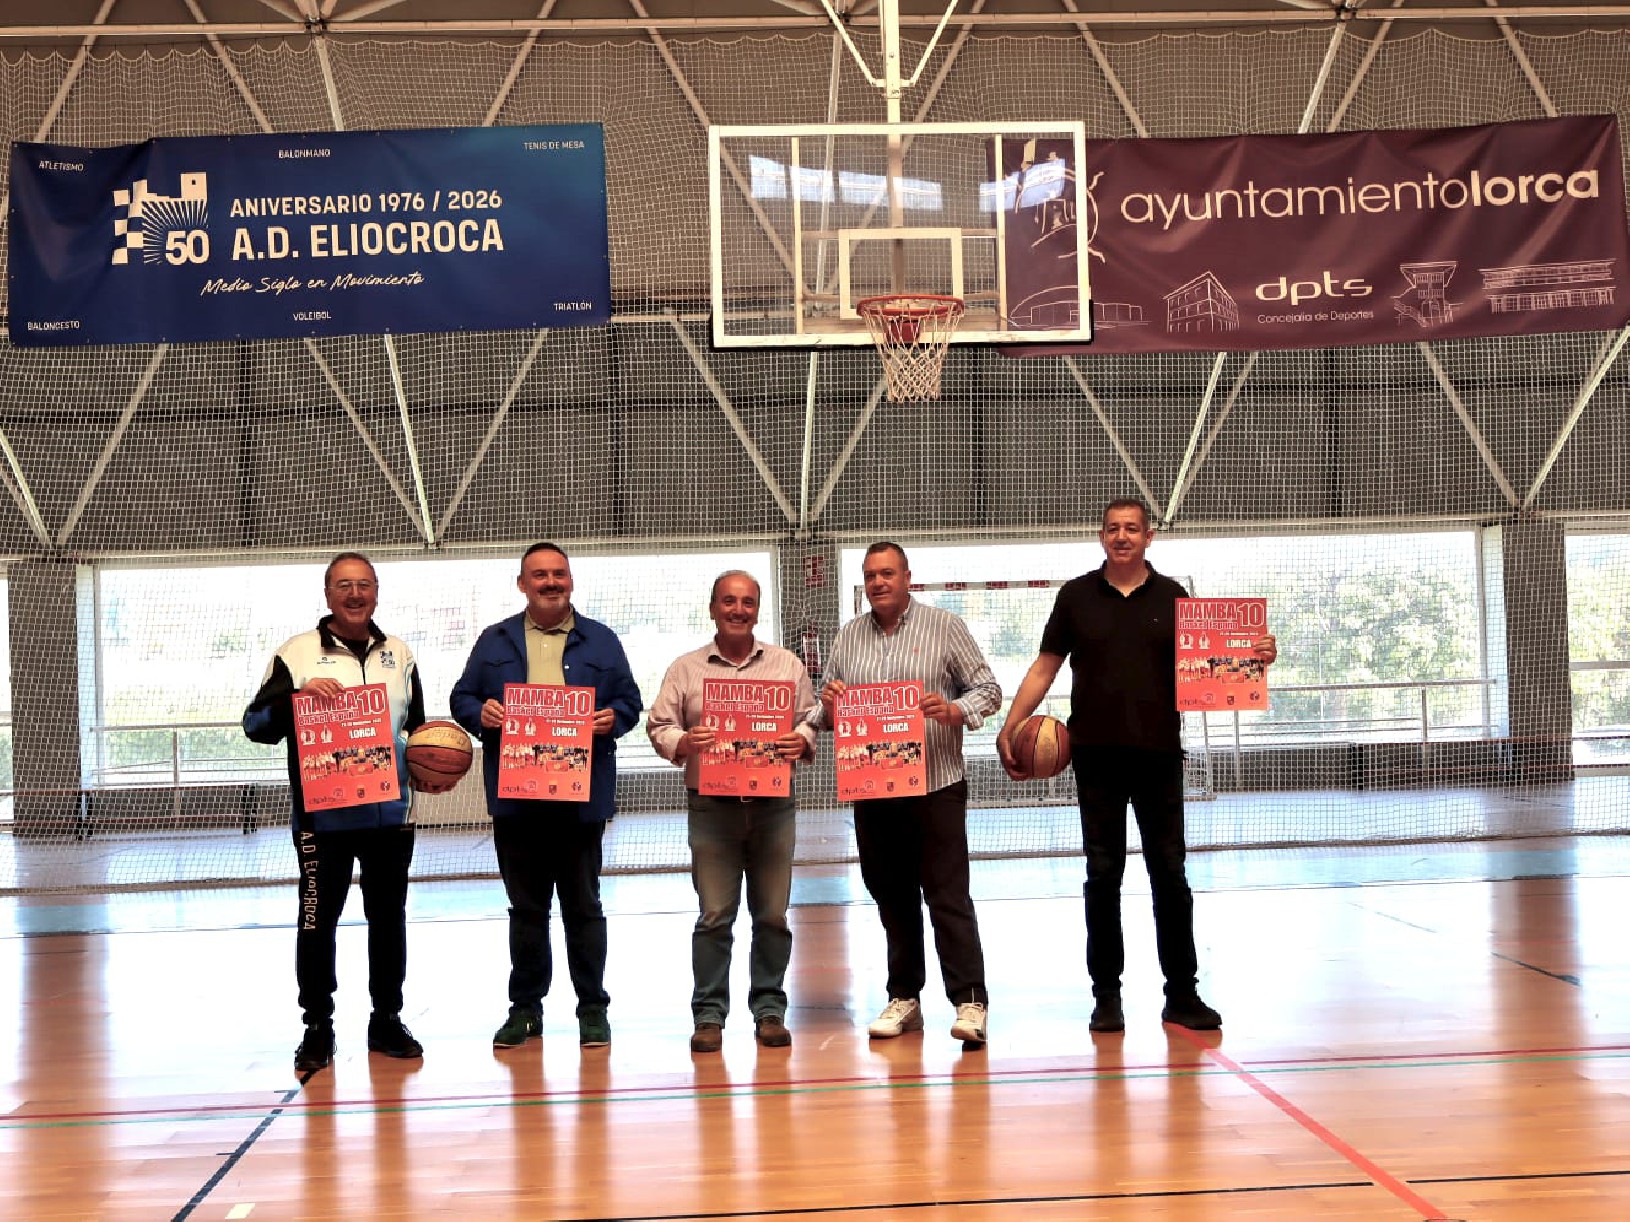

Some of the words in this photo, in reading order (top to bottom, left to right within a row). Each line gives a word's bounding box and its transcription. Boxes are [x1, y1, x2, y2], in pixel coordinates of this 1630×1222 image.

[548, 141, 560, 149] DE
[562, 141, 584, 149] MESA
[278, 149, 330, 158] BALONMANO
[39, 161, 83, 171] ATLETISMO
[230, 195, 371, 217] ANIVERSARIO
[379, 193, 425, 212] 1976
[433, 190, 440, 212] /
[448, 190, 502, 209] 2026
[232, 225, 299, 260] A.D.
[310, 219, 504, 258] ELIOCROCA
[165, 229, 210, 265] 50
[200, 278, 253, 296] Medio
[255, 276, 301, 295] Siglo
[307, 279, 327, 289] en
[329, 271, 425, 290] Movimiento
[1255, 271, 1373, 306] dpts
[293, 311, 332, 320] VOLEIBOL
[1314, 313, 1329, 321] de
[1330, 310, 1374, 321] Deportes
[27, 321, 80, 331] BALONCESTO
[1178, 602, 1238, 620] MAMBA
[1237, 602, 1264, 627] 10
[1226, 639, 1252, 648] LORCA
[295, 690, 359, 716] MAMBA
[357, 688, 386, 716] 10
[506, 688, 564, 707] MAMBA
[564, 690, 591, 717] 10
[705, 683, 764, 703] MAMBA
[763, 686, 791, 711] 10
[837, 686, 894, 707] MAMBA
[892, 684, 920, 711] 10
[348, 726, 377, 739] LORCA
[552, 727, 577, 737] LORCA
[751, 722, 777, 732] LORCA
[883, 722, 909, 733] LORCA
